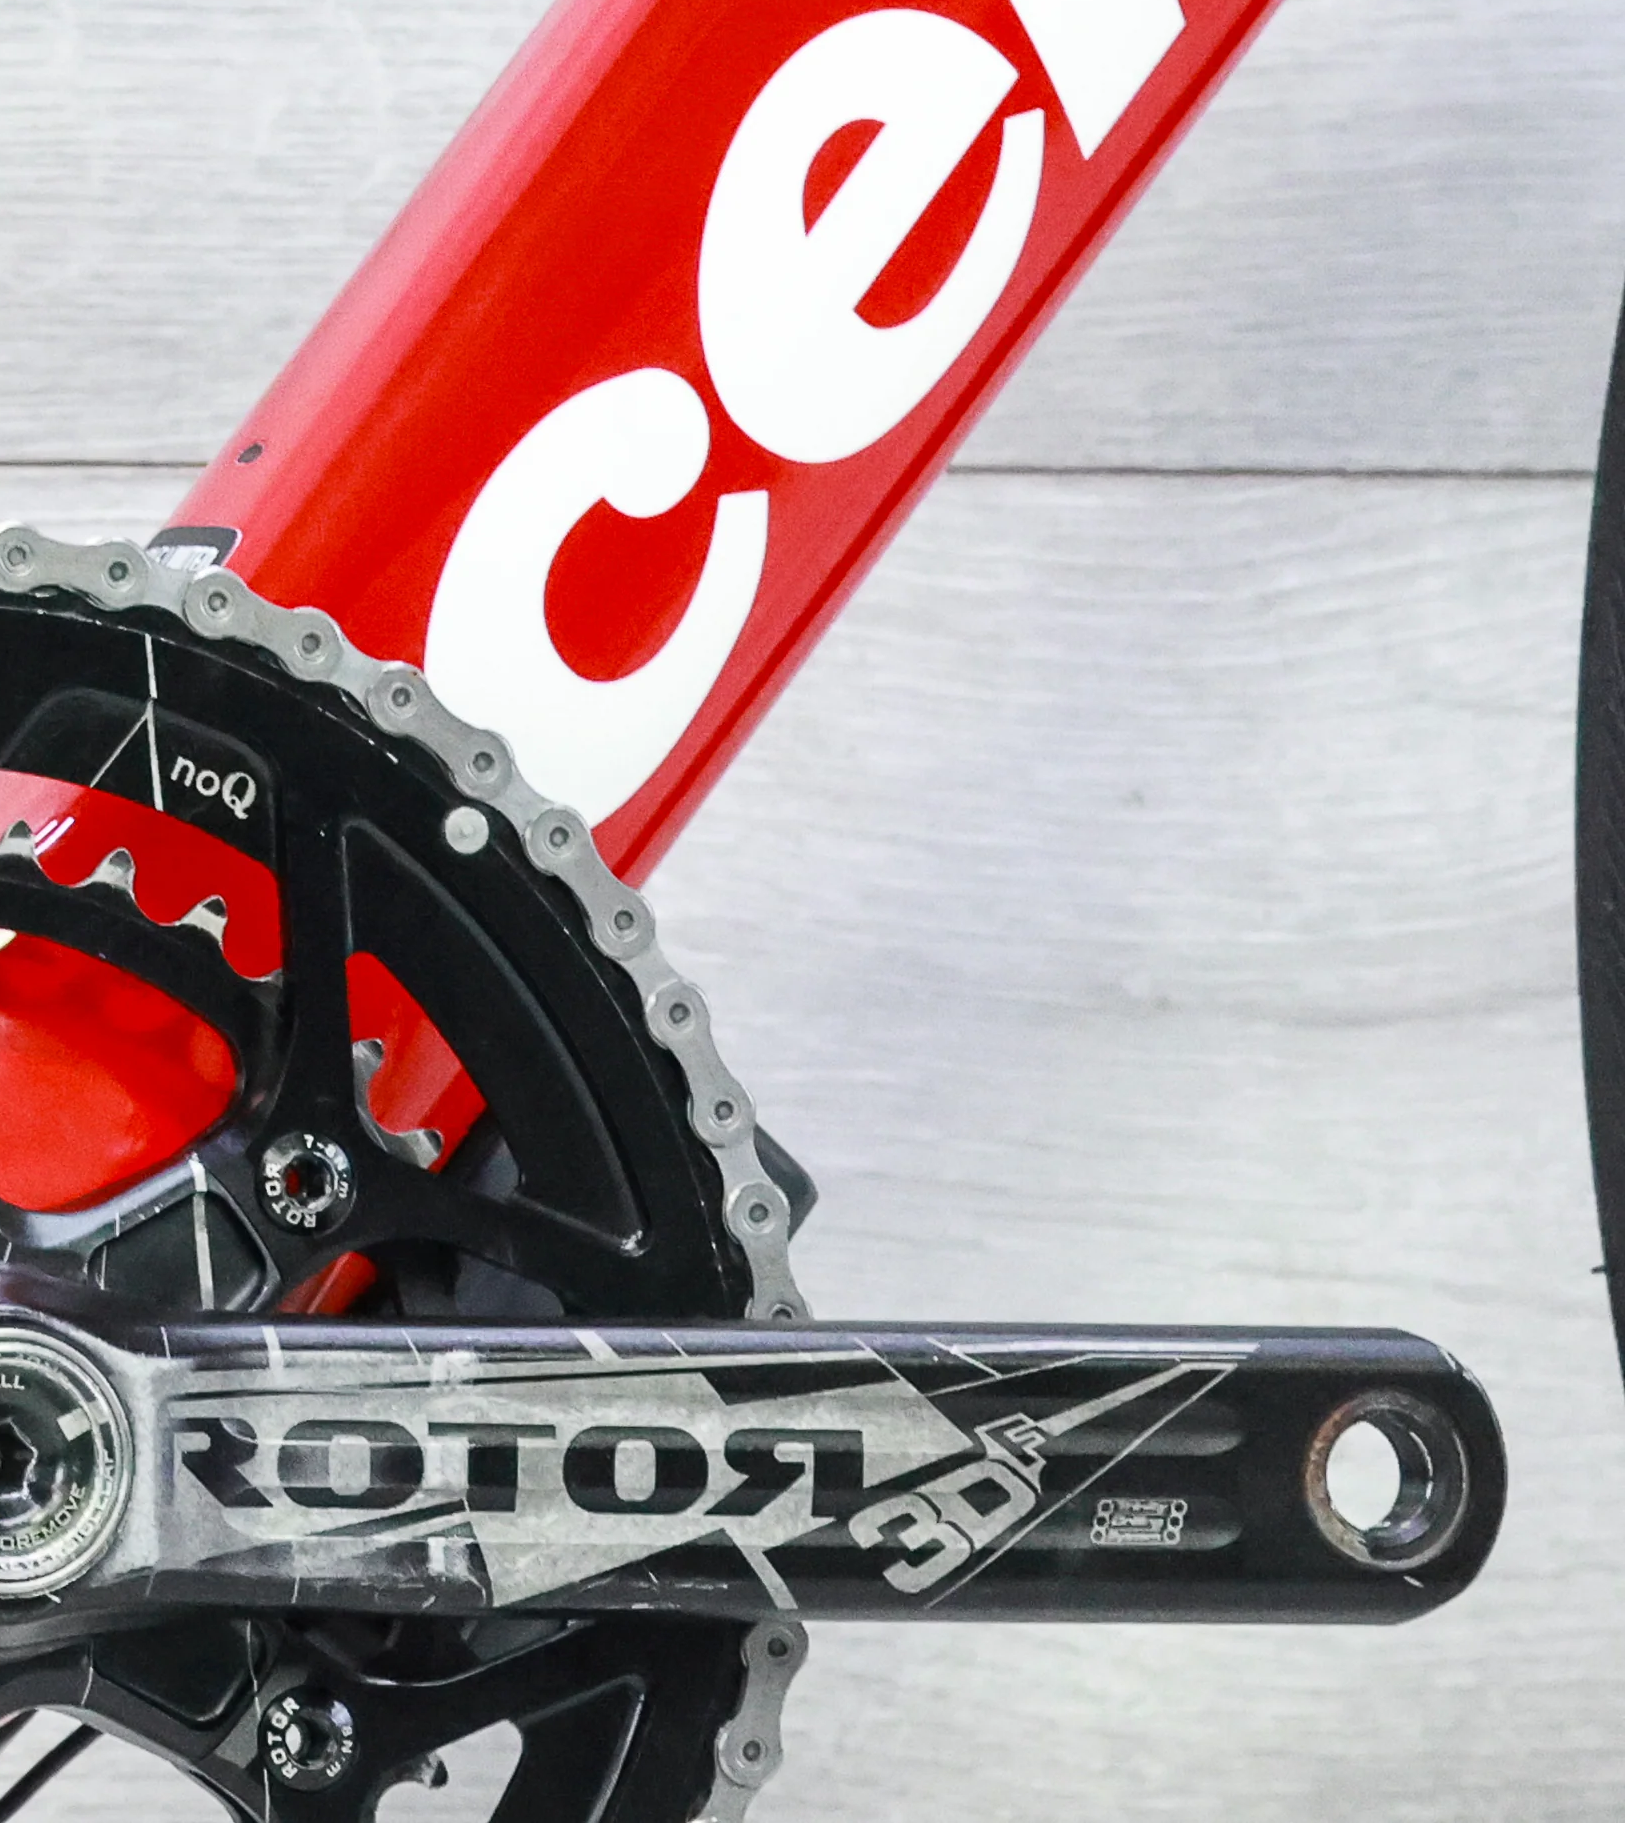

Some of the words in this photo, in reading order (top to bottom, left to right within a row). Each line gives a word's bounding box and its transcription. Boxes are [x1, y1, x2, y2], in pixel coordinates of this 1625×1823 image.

[170, 755, 257, 820] noQ
[265, 1163, 317, 1228] ROTOR
[167, 1417, 865, 1519] ROTOR
[267, 1696, 301, 1779] ROTOR
